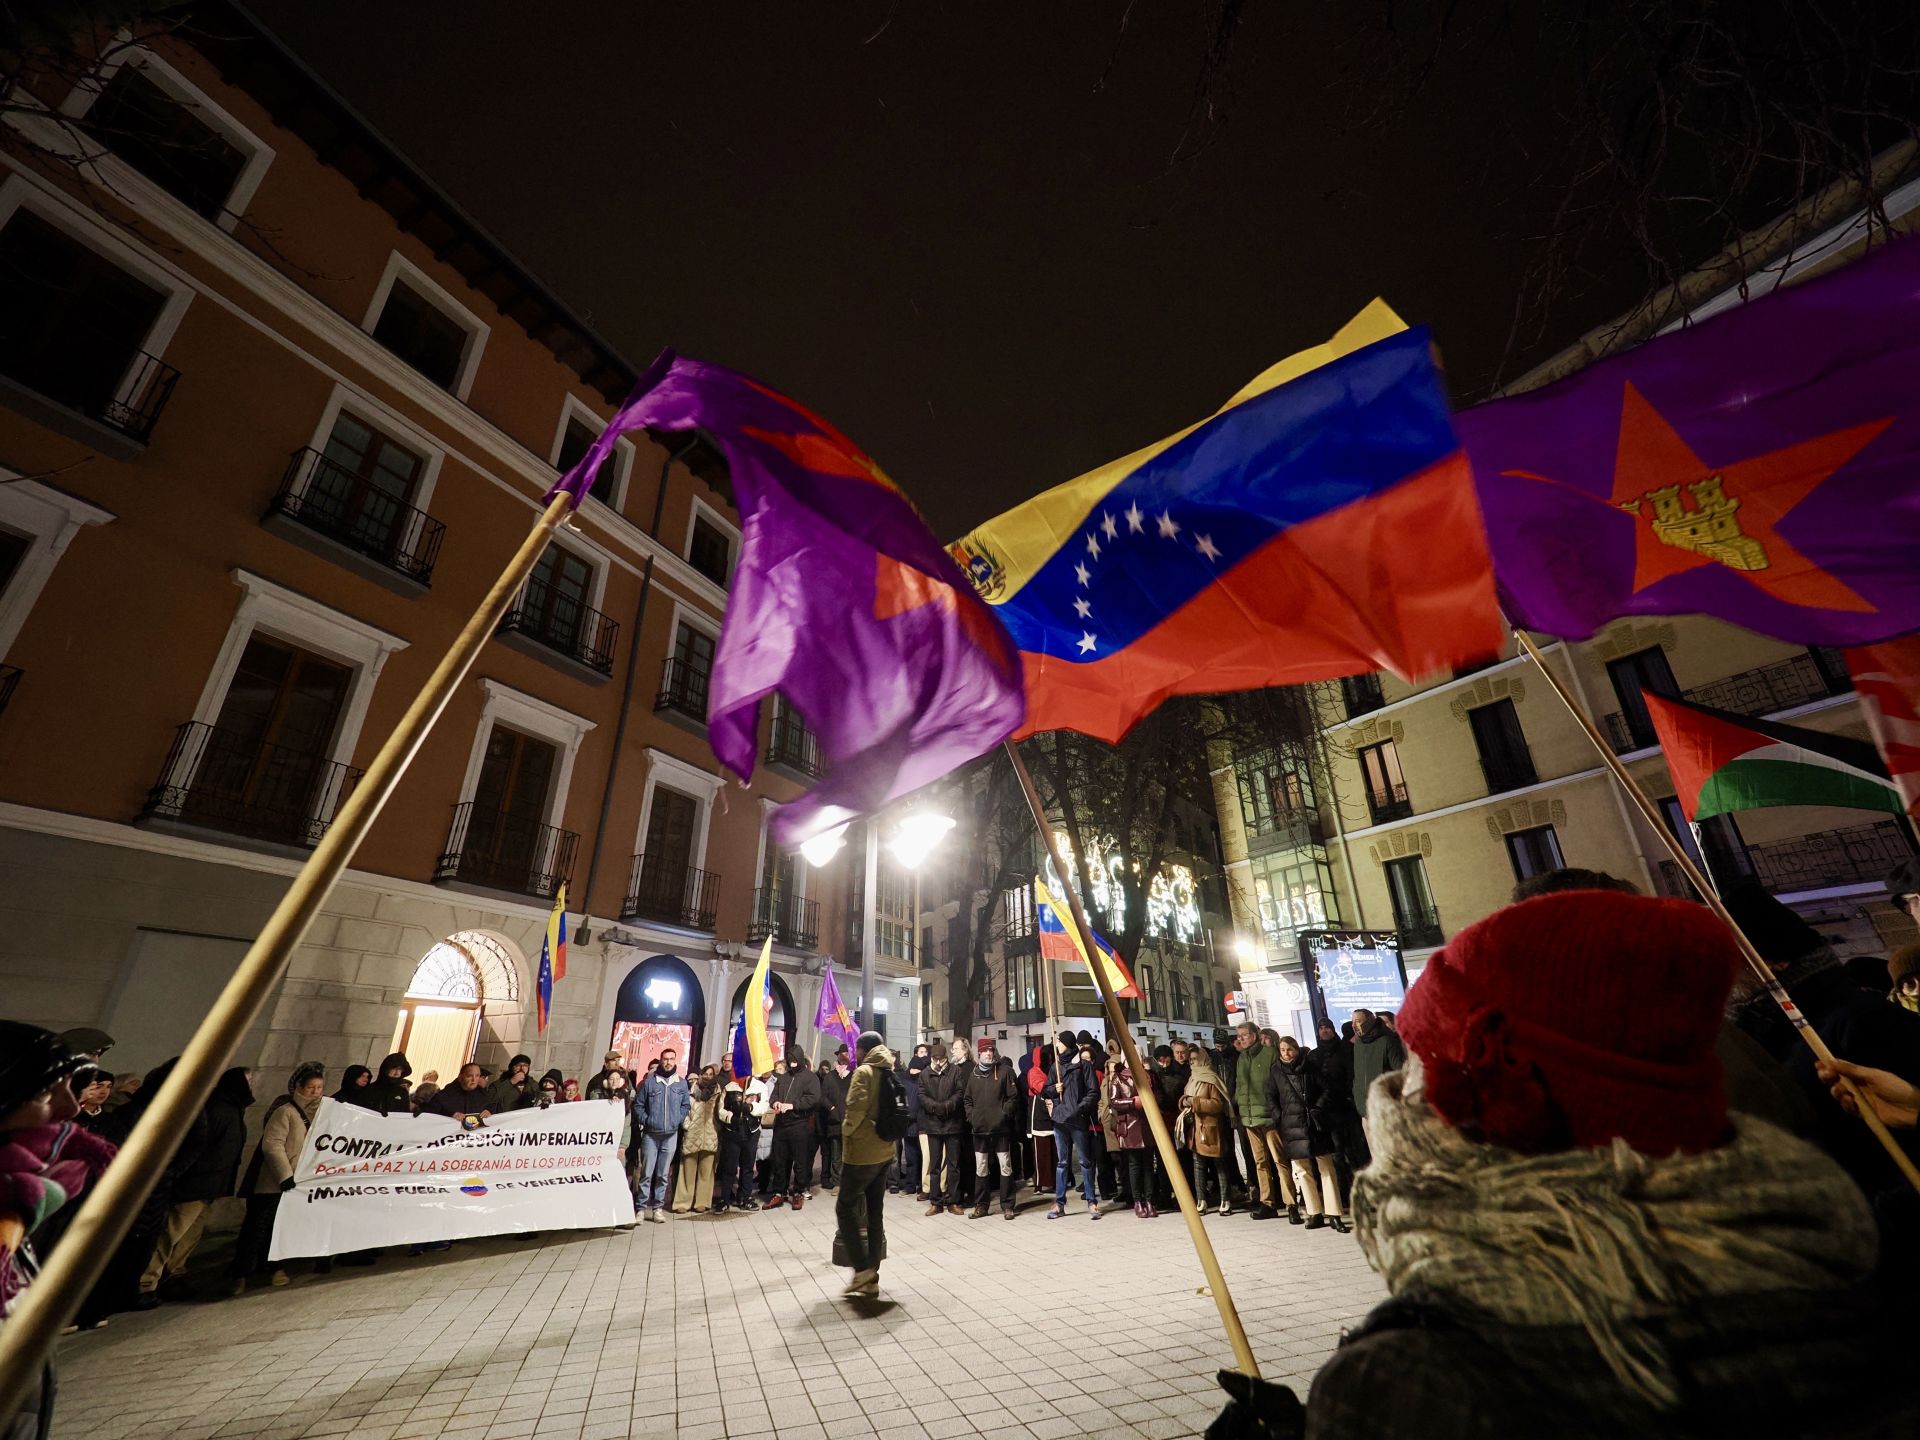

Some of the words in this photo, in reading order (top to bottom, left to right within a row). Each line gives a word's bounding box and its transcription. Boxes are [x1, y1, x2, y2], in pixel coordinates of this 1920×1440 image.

[519, 1131, 614, 1147] IMPERIALISTA
[351, 1162, 370, 1173] LA
[373, 1160, 404, 1173] PAZ
[408, 1160, 418, 1172] Y
[419, 1160, 437, 1172] LA
[440, 1156, 511, 1171] SOBERANÍA
[515, 1158, 529, 1169] DE
[532, 1157, 554, 1169] LOS
[557, 1155, 602, 1168] PUEBLOS
[307, 1185, 390, 1203] ¡MANOS
[496, 1182, 517, 1190] DE
[518, 1172, 604, 1188] VENEZUELA!
